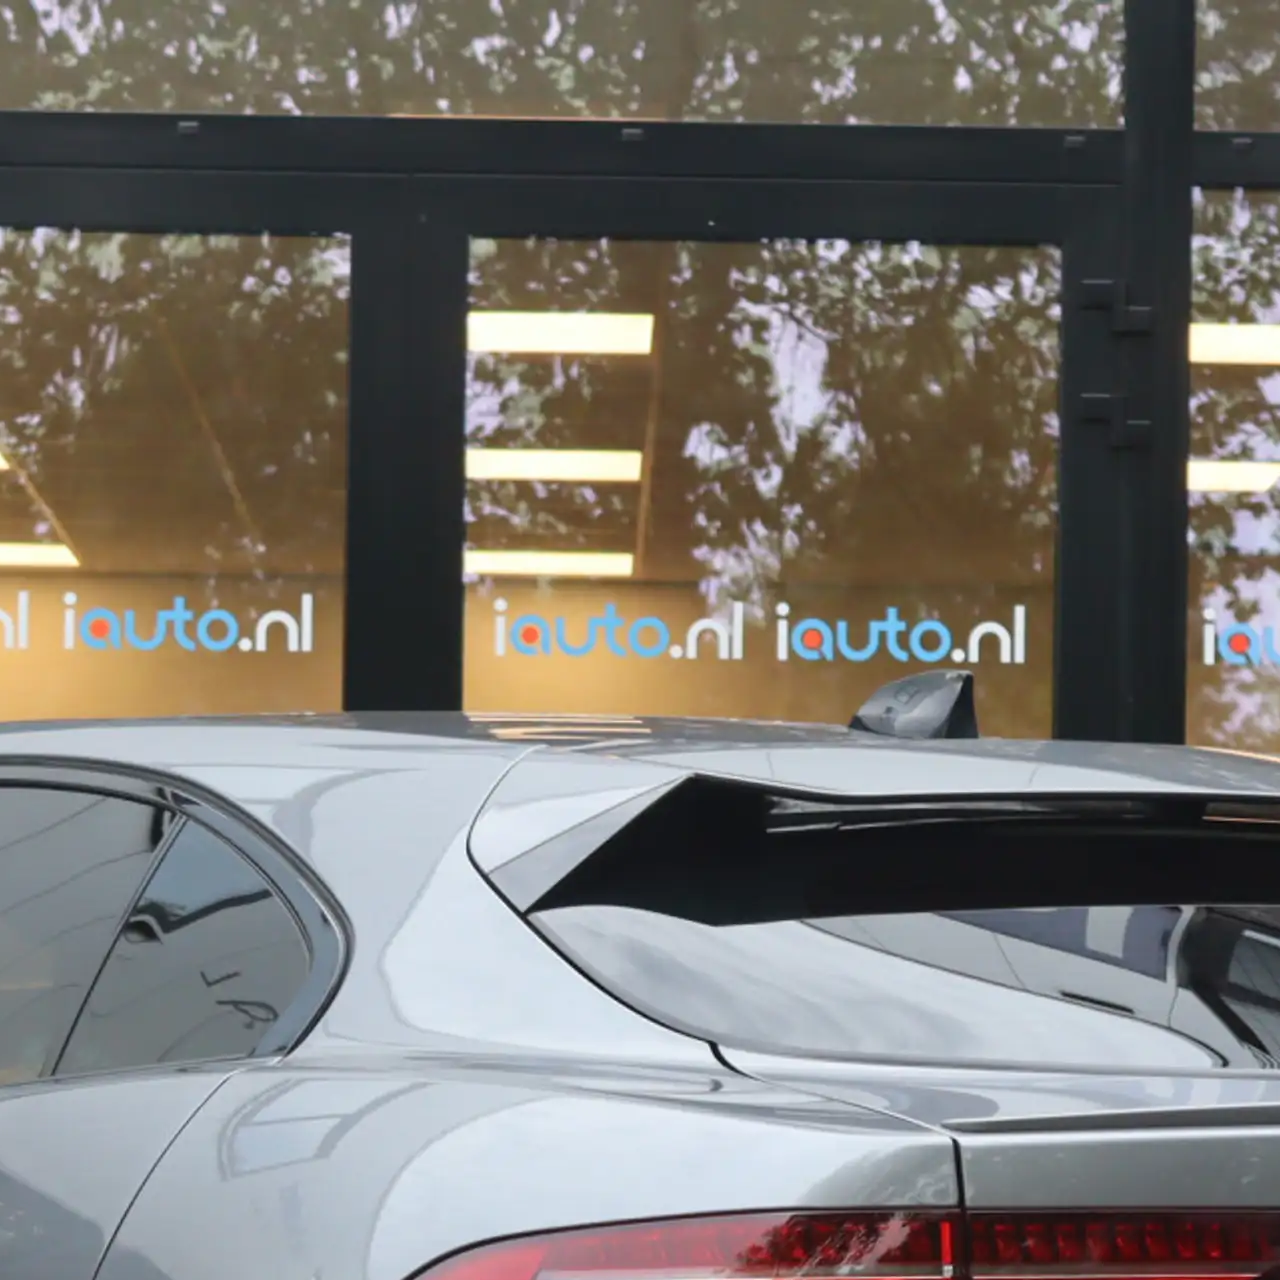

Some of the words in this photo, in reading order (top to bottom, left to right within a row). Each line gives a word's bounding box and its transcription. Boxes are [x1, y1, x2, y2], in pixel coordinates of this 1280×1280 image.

[63, 591, 313, 652] iauto.nl
[493, 598, 743, 660] iauto.nl
[776, 602, 1026, 664] iauto.nl
